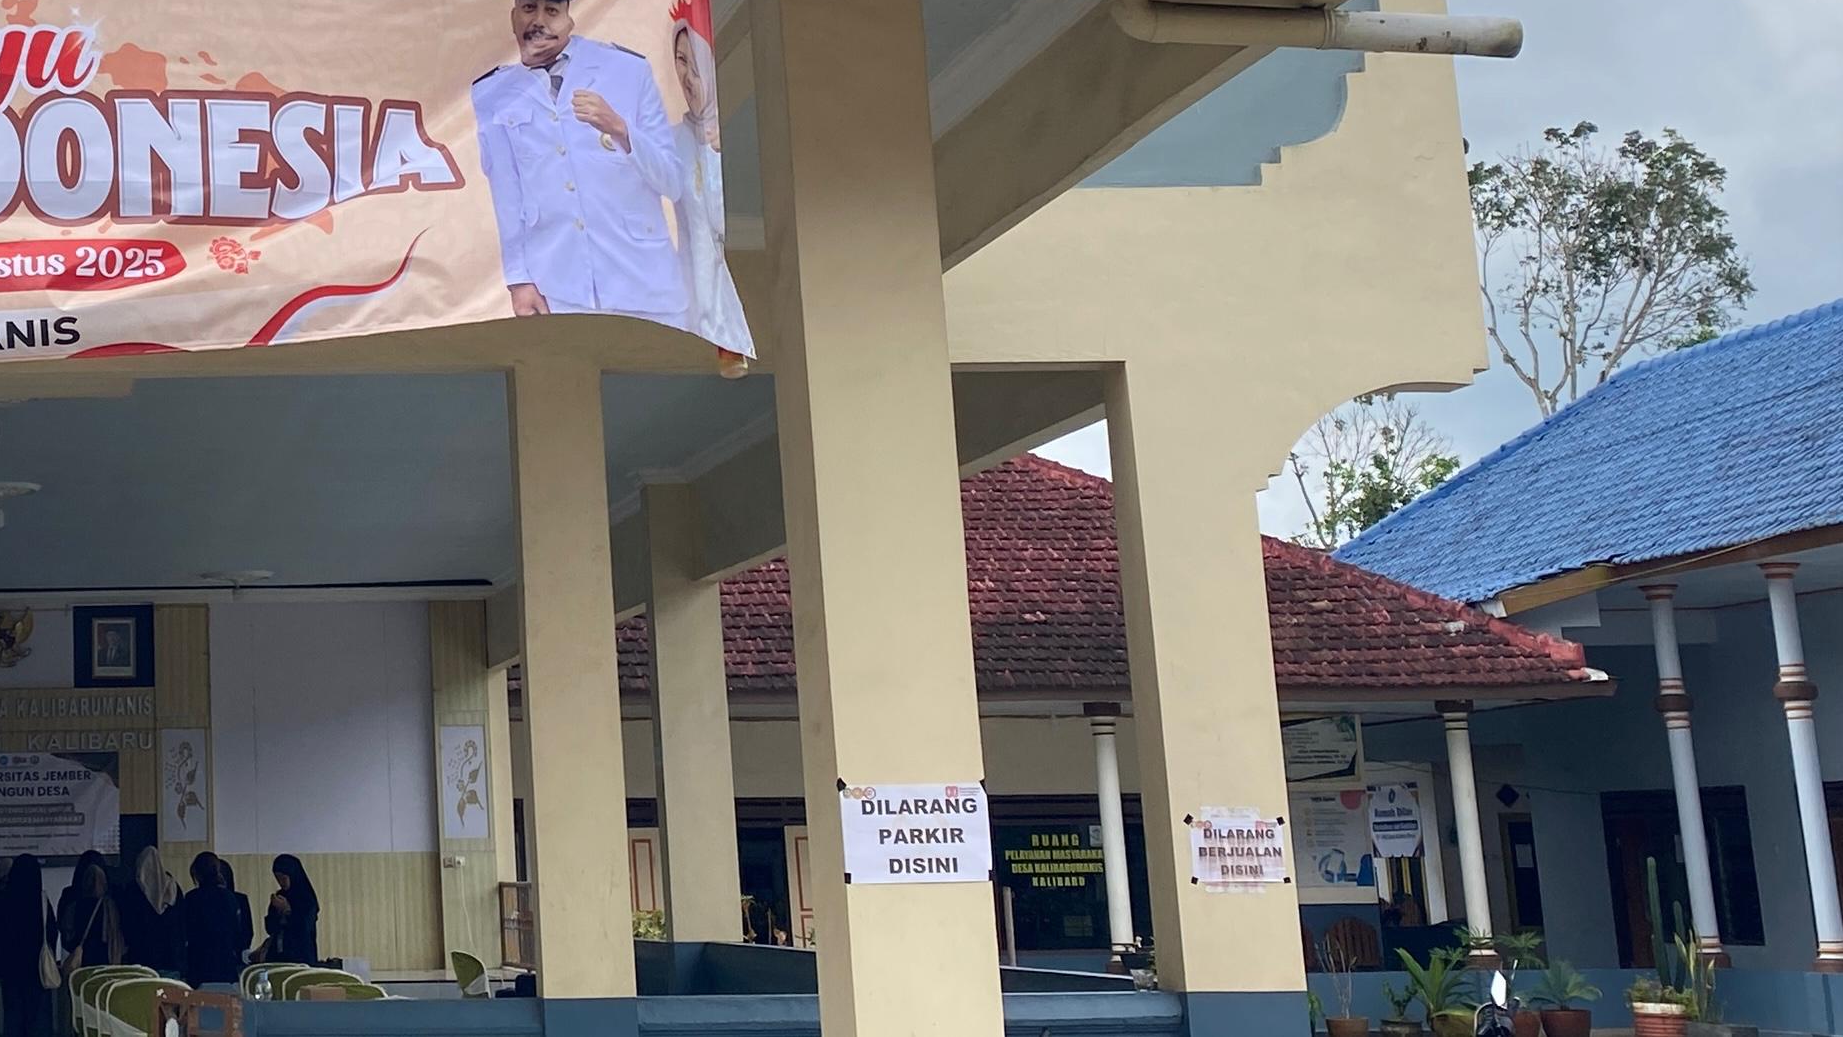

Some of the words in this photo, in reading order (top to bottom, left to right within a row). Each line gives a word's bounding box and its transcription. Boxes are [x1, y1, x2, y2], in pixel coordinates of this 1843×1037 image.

[75, 246, 166, 279] 2025
[17, 695, 153, 718] KALIBARUMANIS
[27, 732, 153, 752] KALIBARU
[42, 770, 92, 782] JEMBER
[37, 785, 70, 797] DESA
[861, 798, 978, 815] DILARANG
[879, 827, 965, 845] PARKIR
[1203, 829, 1275, 839] DILARANG
[1031, 834, 1080, 847] RUANG
[1052, 849, 1104, 860] MASYARAKA
[1198, 847, 1283, 858] BERJUALAN
[889, 857, 959, 874] DISINI
[1220, 865, 1264, 876] DISINI
[1032, 876, 1086, 887] KALIBARU
